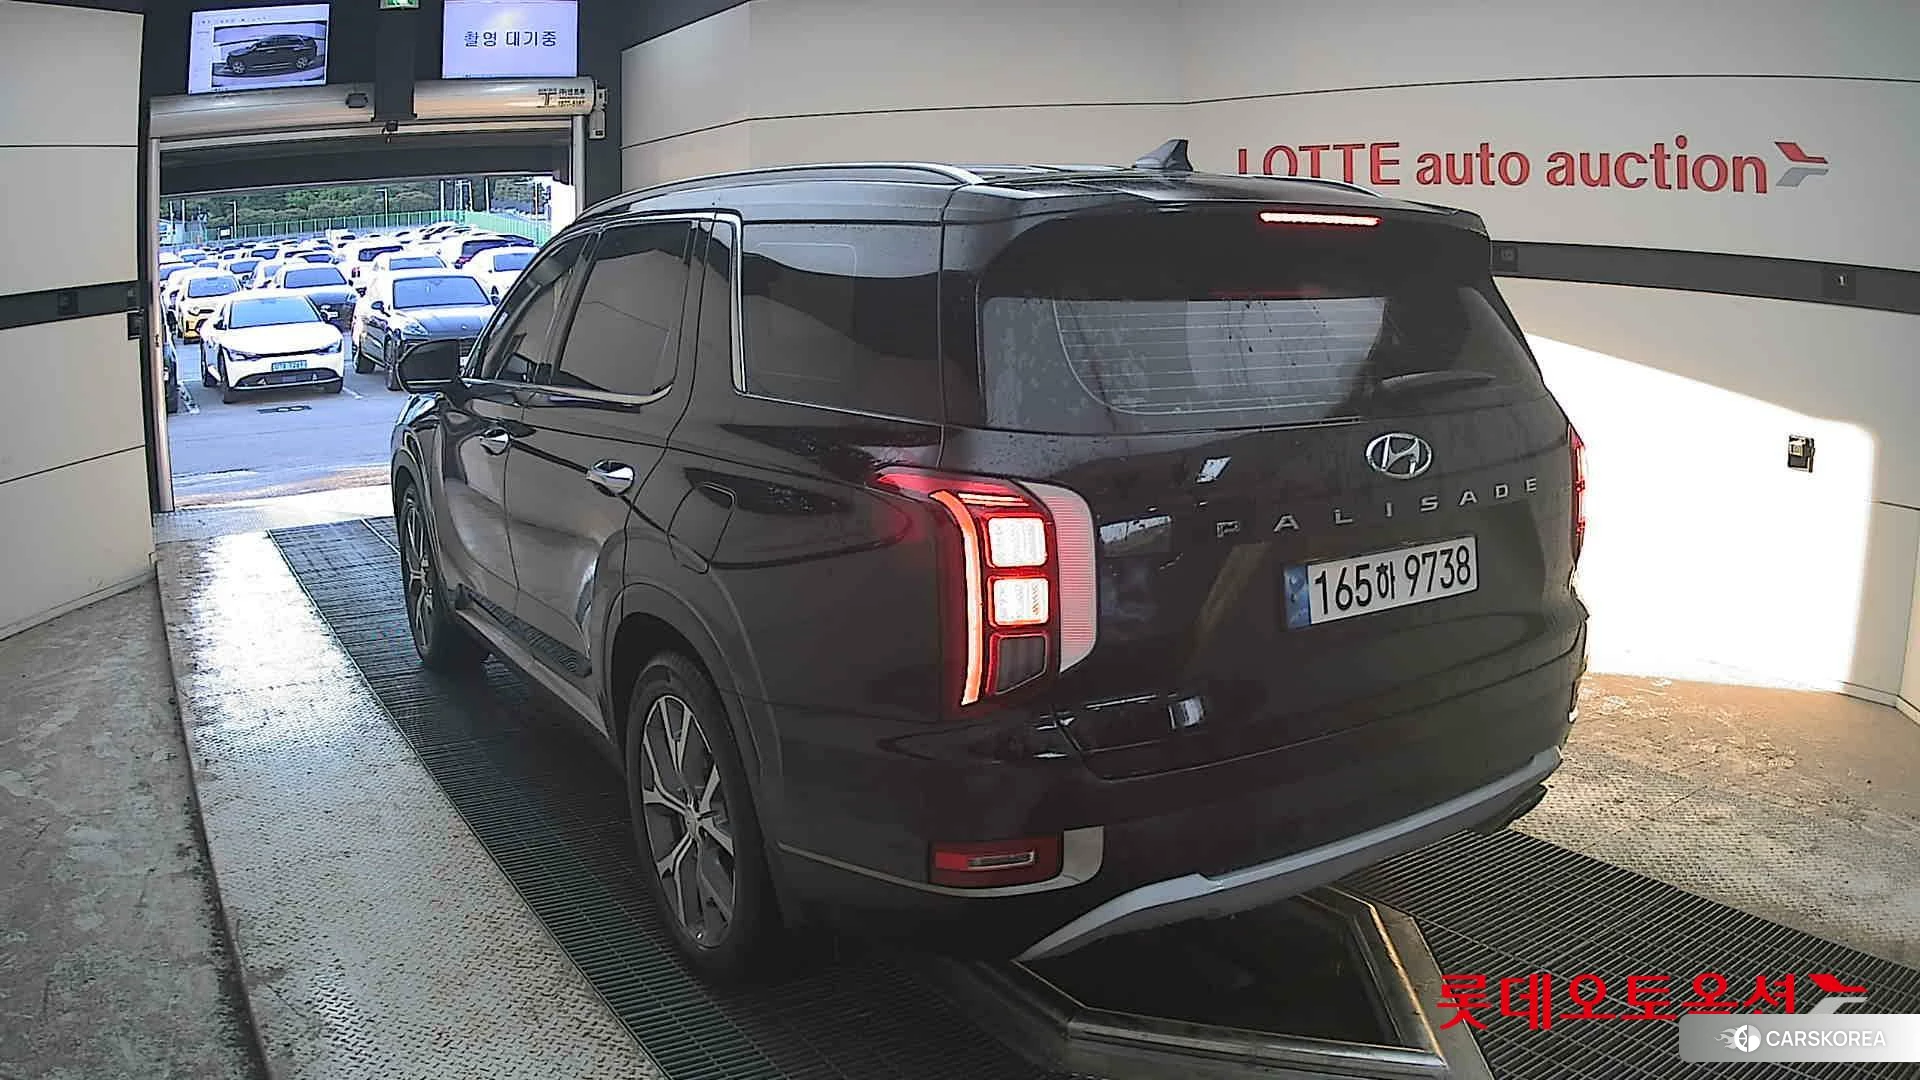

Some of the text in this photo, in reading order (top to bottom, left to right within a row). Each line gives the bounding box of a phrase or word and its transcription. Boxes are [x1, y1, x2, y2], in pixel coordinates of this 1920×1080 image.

[505, 31, 557, 47] 대기중
[1416, 142, 1530, 186] auto
[1546, 134, 1768, 194] auction
[1216, 477, 1538, 538] PALISADE
[1314, 545, 1472, 614] 165하 9738
